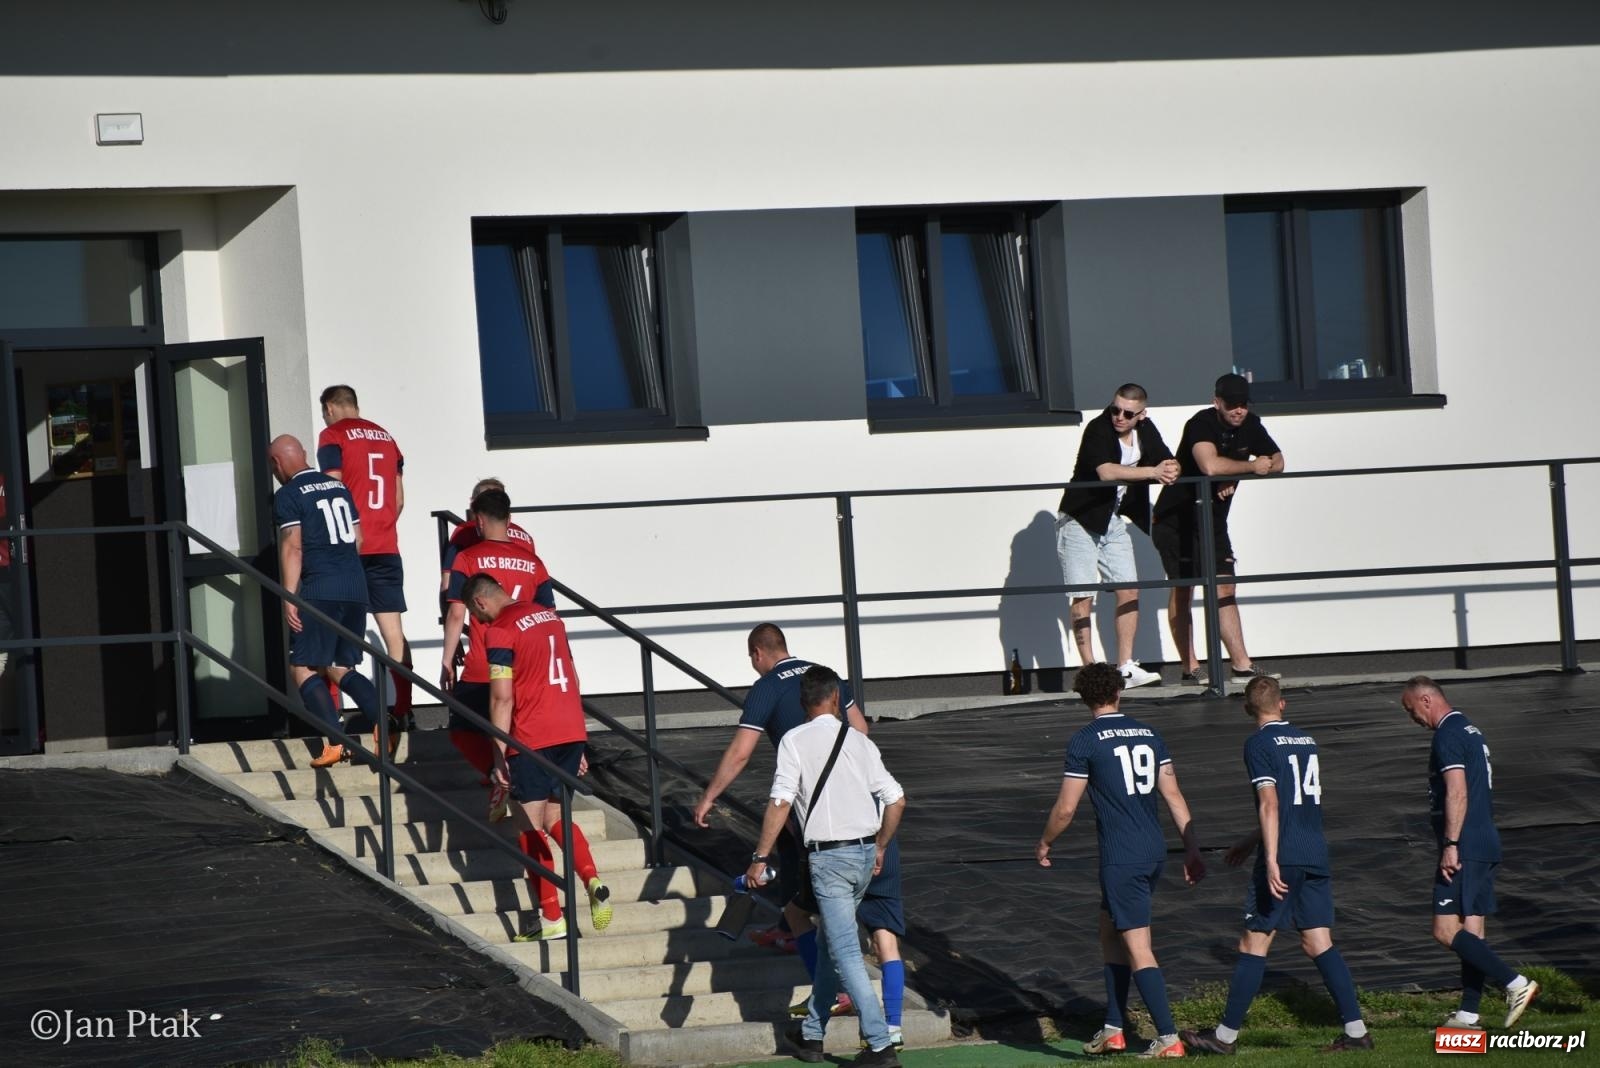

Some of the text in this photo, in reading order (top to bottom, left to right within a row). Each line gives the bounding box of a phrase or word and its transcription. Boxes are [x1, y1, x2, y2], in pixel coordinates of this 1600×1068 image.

[345, 428, 364, 441] LKS
[367, 453, 384, 510] 5
[316, 497, 356, 544] 10
[477, 556, 536, 575] LKS BRZEZIE
[515, 615, 536, 632] LKS
[548, 635, 568, 693] 4
[1097, 729, 1115, 741] LKS
[1113, 744, 1155, 796] 19
[1288, 754, 1322, 805] 14
